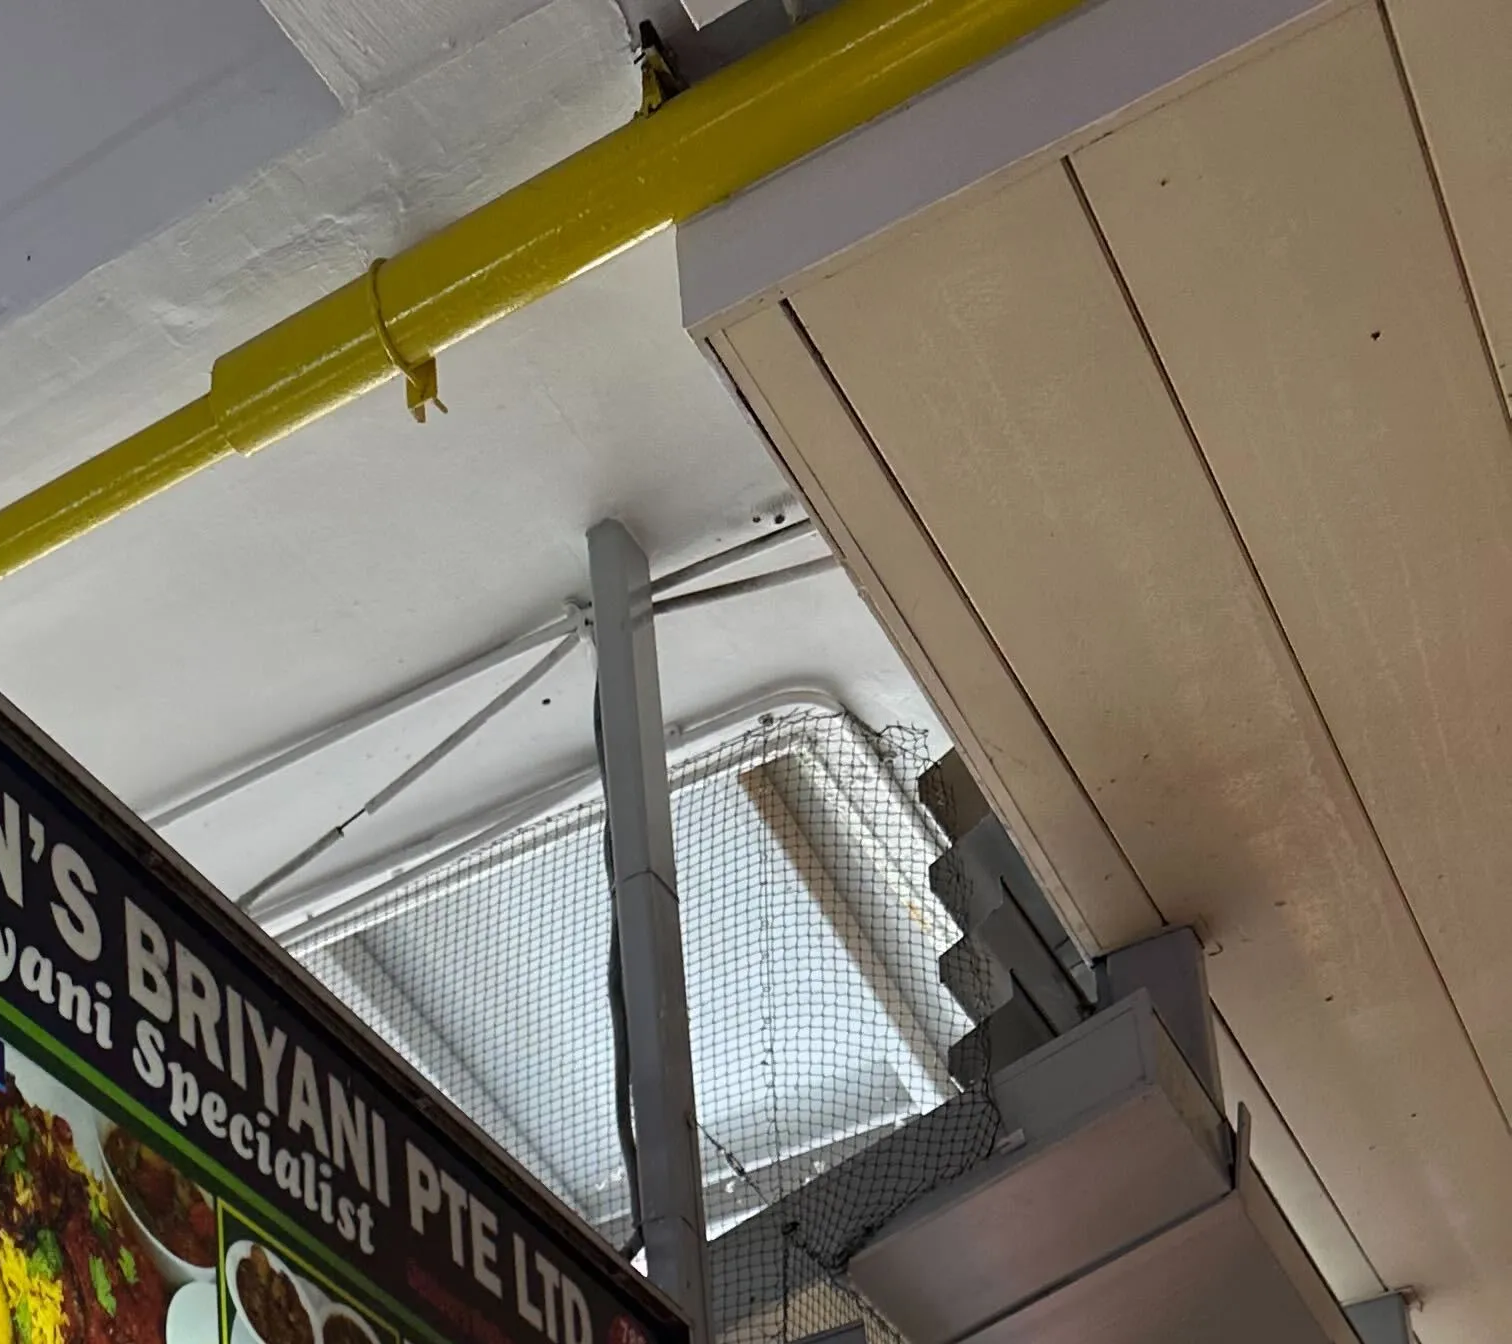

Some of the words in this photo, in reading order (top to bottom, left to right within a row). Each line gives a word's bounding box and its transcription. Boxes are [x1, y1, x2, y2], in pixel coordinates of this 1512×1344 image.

[125, 903, 392, 1207] BRIYANI
[406, 1135, 502, 1298] PTE
[132, 1019, 375, 1254] Specialist
